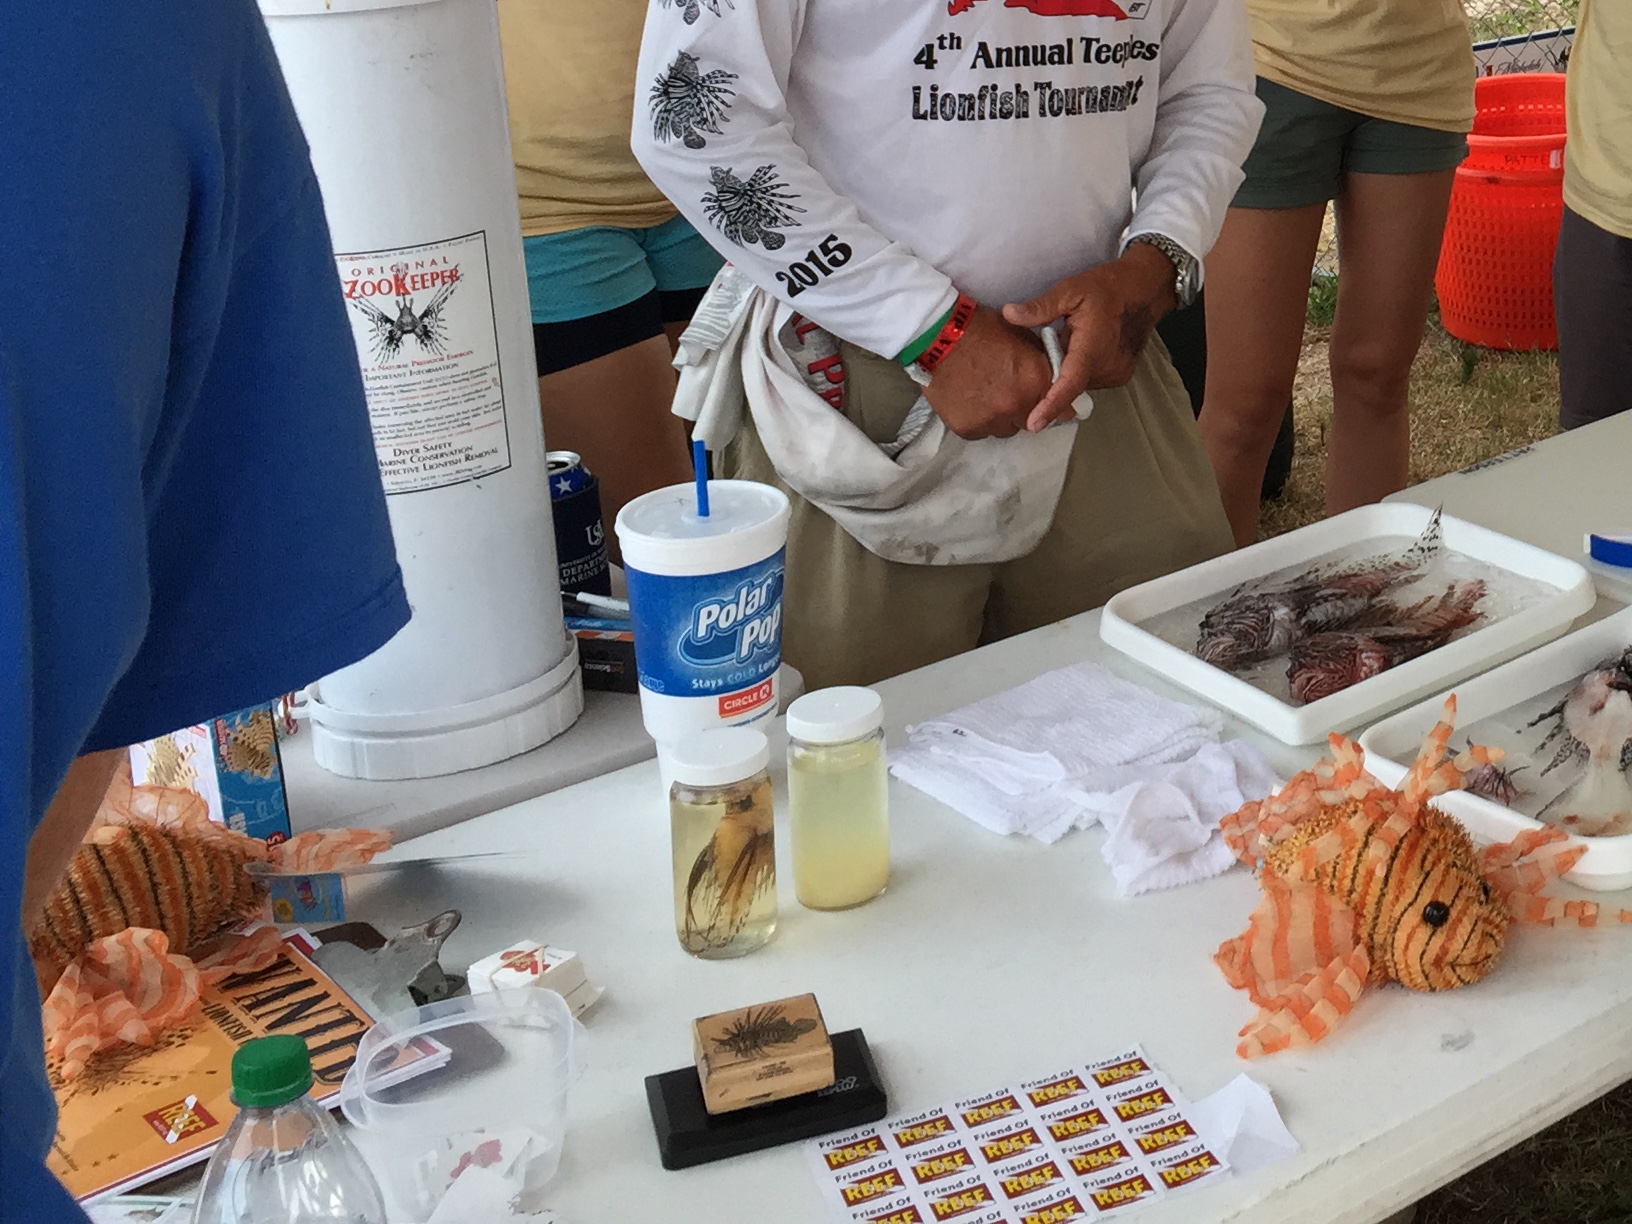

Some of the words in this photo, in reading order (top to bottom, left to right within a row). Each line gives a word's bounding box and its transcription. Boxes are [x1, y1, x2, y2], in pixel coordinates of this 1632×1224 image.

[912, 32, 962, 70] 4th
[970, 38, 1074, 70] Annual
[912, 83, 1030, 121] Lionfish
[351, 256, 448, 276] ORIGINAL
[774, 233, 853, 298] 2015
[410, 446, 474, 463] CONSERVATION
[423, 441, 452, 452] SAFETY
[464, 447, 498, 462] REMOVAL
[697, 576, 772, 638] Polar
[740, 602, 781, 658] Pop
[692, 678, 723, 691] Stays
[727, 667, 756, 685] COLD
[724, 693, 758, 710] CIRCLE
[1124, 1050, 1138, 1059] Of
[1096, 1061, 1142, 1084] REEF
[954, 1092, 993, 1109] Friend
[996, 1088, 1010, 1097] Of
[1032, 1080, 1080, 1103] REEF
[1106, 1085, 1143, 1102] Friend
[1146, 1079, 1159, 1089] Of
[929, 1107, 944, 1116] Of
[965, 1099, 1013, 1124] REEF
[1040, 1103, 1078, 1122] Friend
[1080, 1099, 1095, 1109] Of
[1116, 1092, 1166, 1118] REEF
[898, 1120, 946, 1144] REEF
[974, 1124, 1011, 1142] Friend
[1014, 1119, 1029, 1129] Of
[1051, 1113, 1101, 1138] REEF
[1128, 1118, 1165, 1135] Friend
[1168, 1112, 1182, 1122] Of
[818, 1133, 859, 1150] Friend
[861, 1128, 876, 1137] Of
[984, 1132, 1034, 1159] REEF
[1060, 1138, 1100, 1155] Friend
[1102, 1132, 1116, 1143] Of
[1139, 1124, 1188, 1151] REEF
[828, 1139, 878, 1166] REEF
[904, 1144, 945, 1162] Friend
[947, 1139, 962, 1149] Of
[1074, 1145, 1122, 1171] REEF
[1150, 1151, 1188, 1168] Friend
[1191, 1144, 1206, 1154] Of
[834, 1165, 876, 1184] Friend
[878, 1160, 893, 1169] Of
[916, 1152, 966, 1178] REEF
[993, 1158, 1033, 1176] Friend
[1035, 1153, 1050, 1163] Of
[1162, 1156, 1212, 1183] REEF
[845, 1172, 896, 1202] REEF
[923, 1182, 964, 1198] Friend
[966, 1174, 982, 1185] Of
[1004, 1166, 1056, 1194] REEF
[1082, 1171, 1122, 1189] Friend
[1125, 1166, 1139, 1176] Of
[934, 1188, 986, 1216] REEF
[1014, 1193, 1054, 1213] Friend
[1056, 1187, 1072, 1198] Of
[1094, 1178, 1145, 1206] REEF
[852, 1202, 893, 1220] Friend
[896, 1196, 911, 1206] Of
[986, 1210, 1001, 1221] Of
